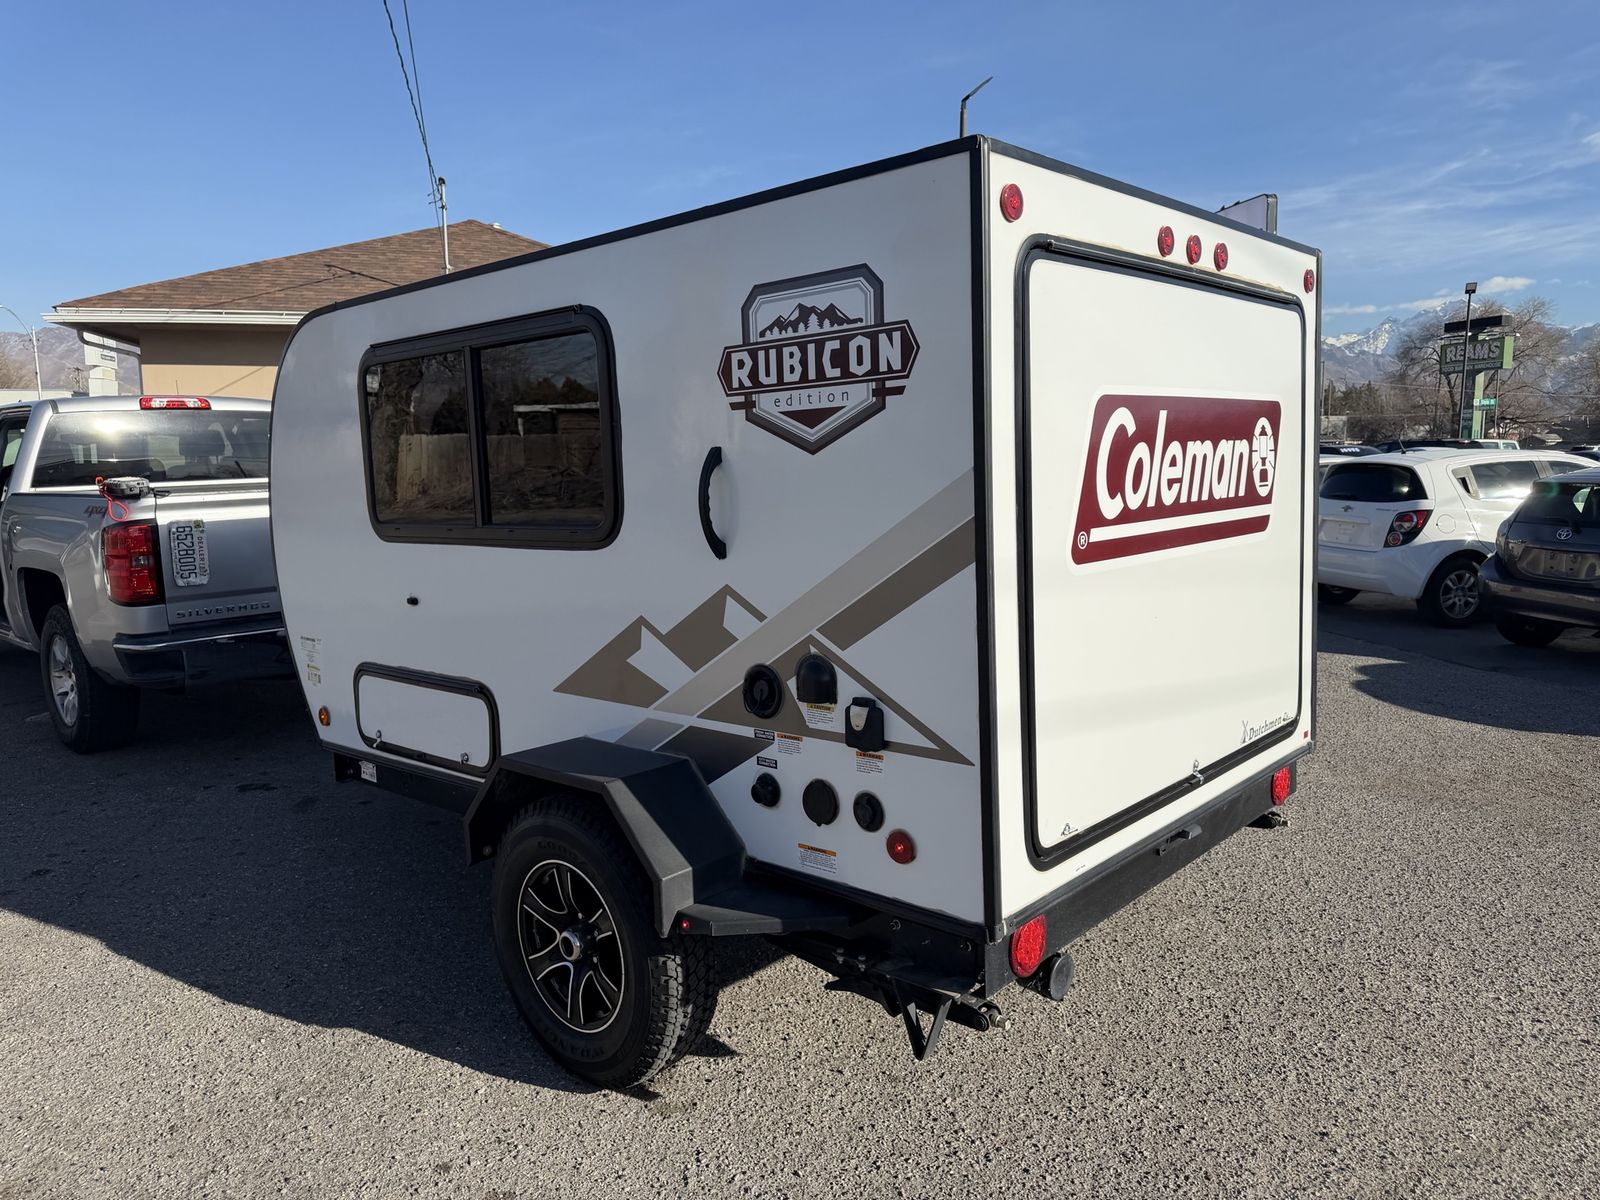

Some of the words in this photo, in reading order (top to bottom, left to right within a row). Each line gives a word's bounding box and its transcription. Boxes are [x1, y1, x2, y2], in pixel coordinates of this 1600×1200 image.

[730, 330, 903, 389] RUBICON
[773, 390, 850, 408] edition
[1095, 406, 1250, 520] Coleman
[197, 536, 205, 562] DEALER
[1248, 716, 1282, 741] Dutchmen
